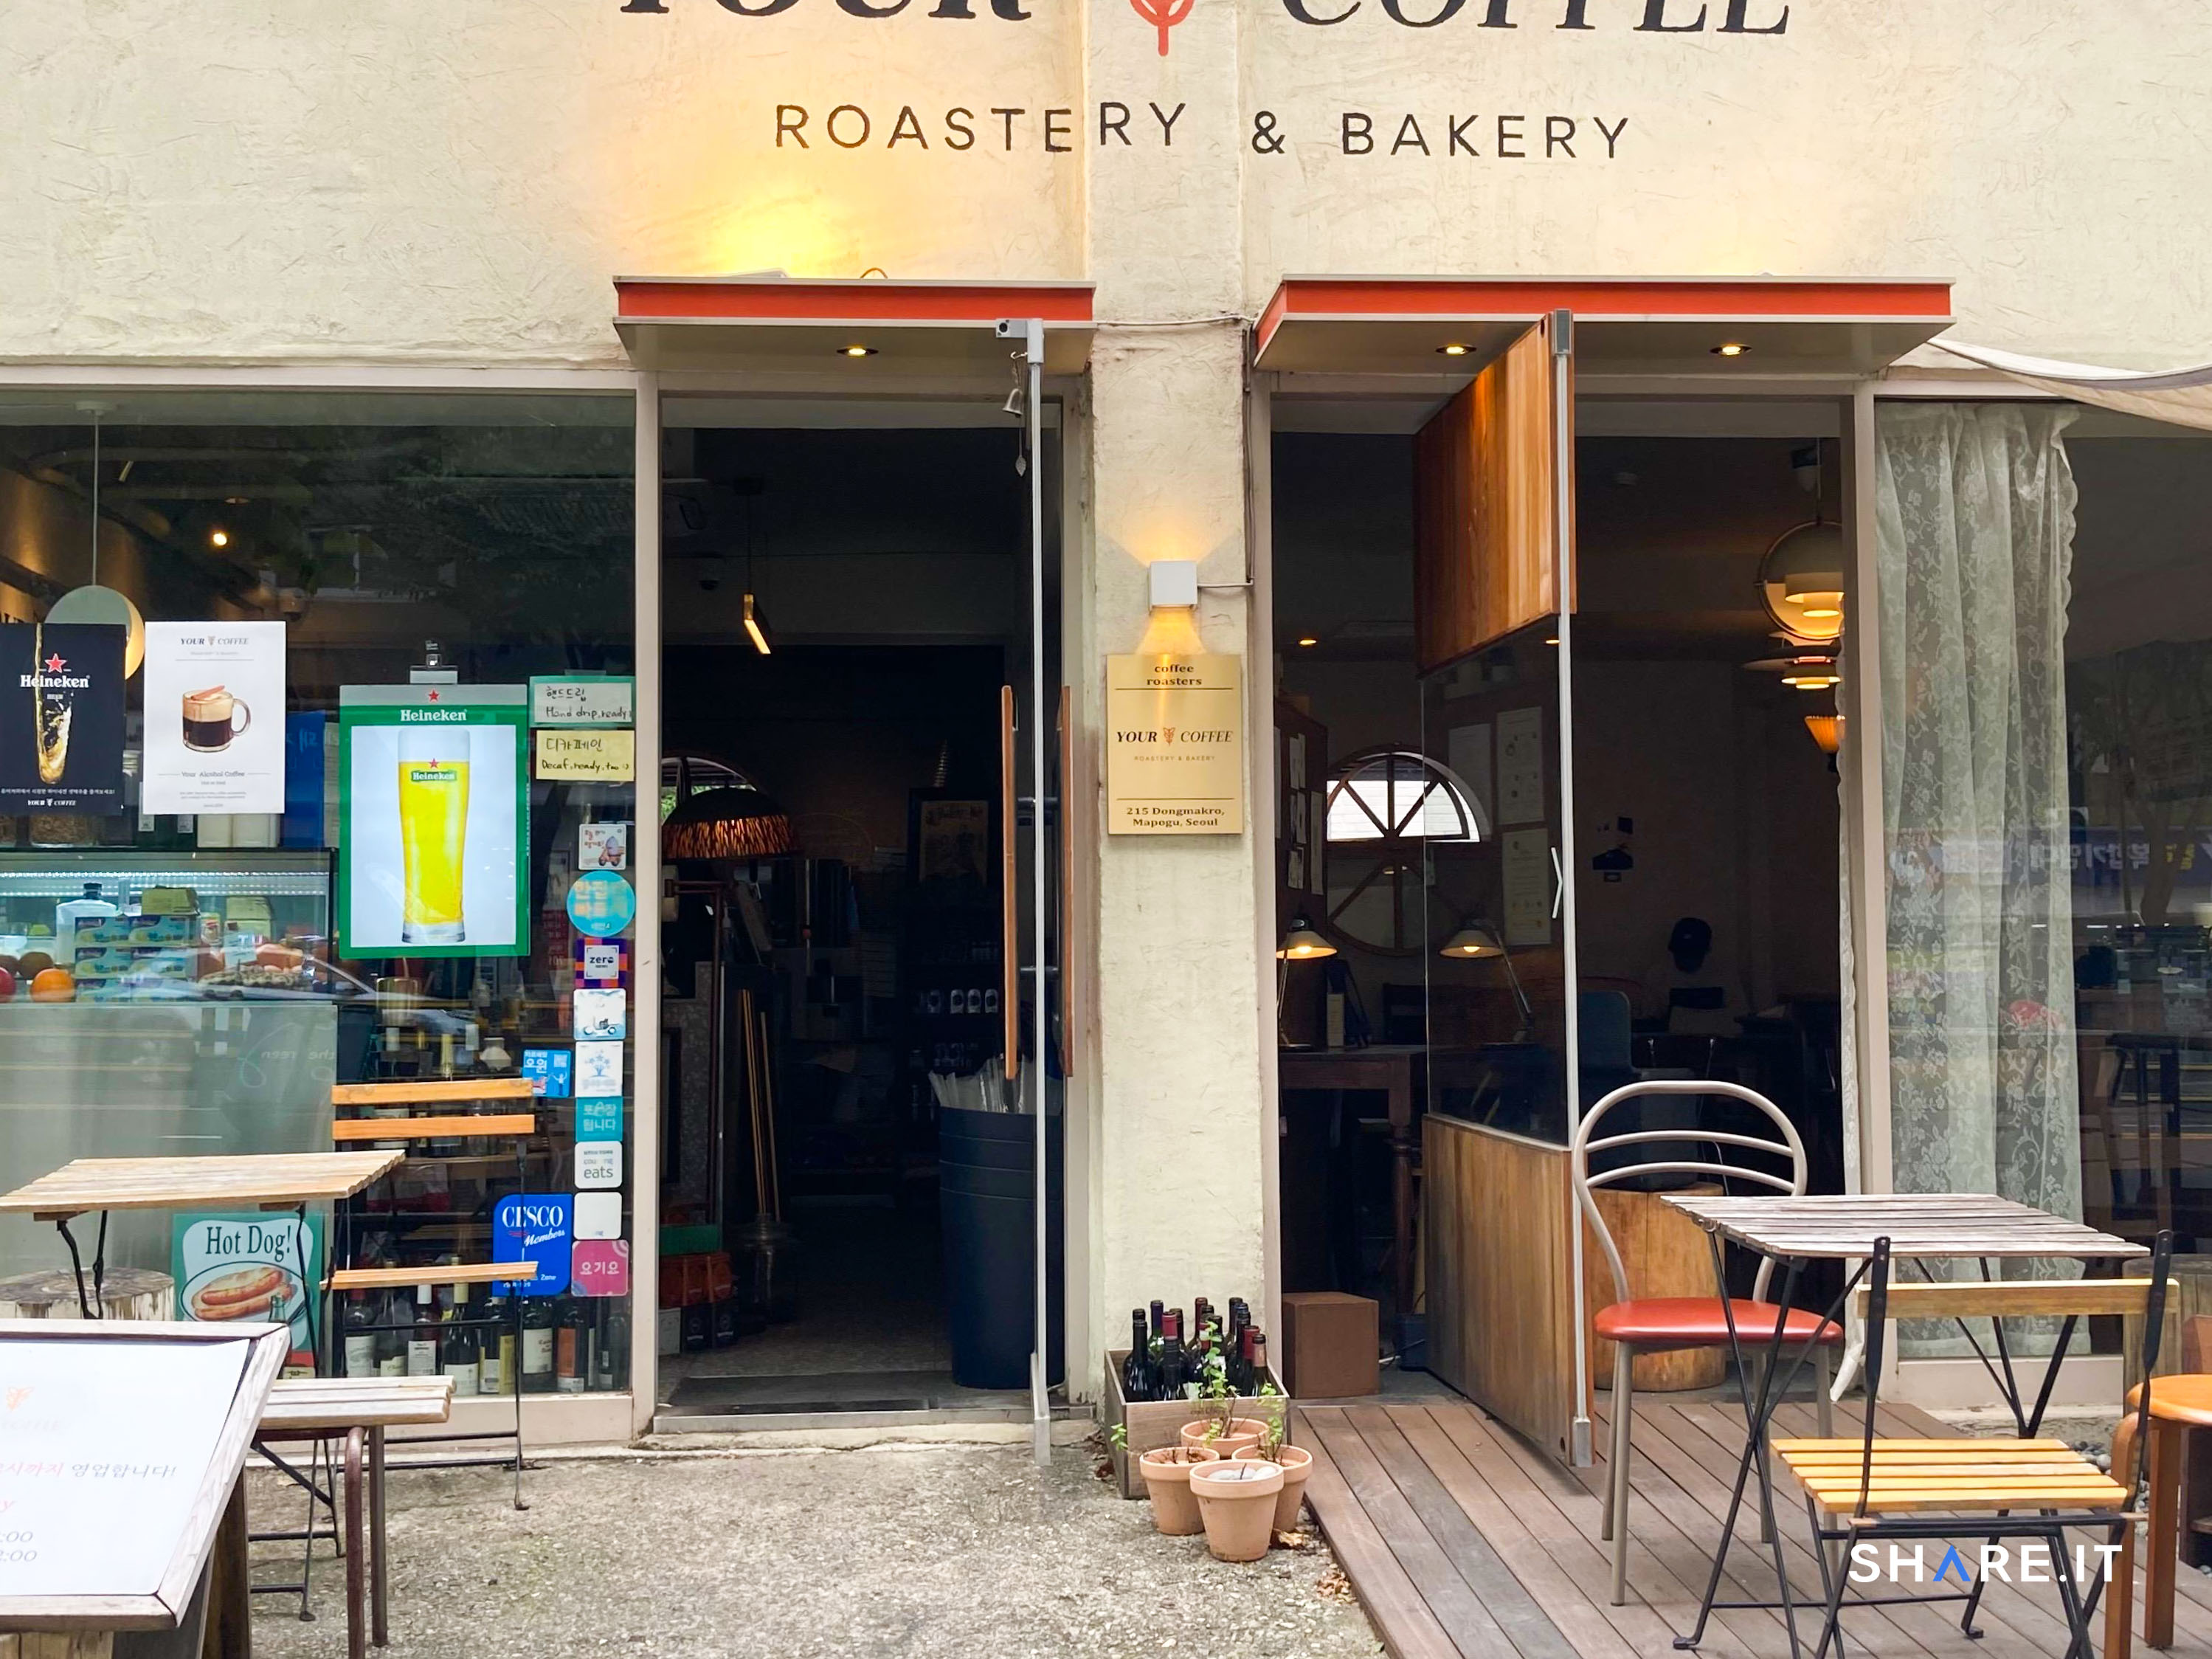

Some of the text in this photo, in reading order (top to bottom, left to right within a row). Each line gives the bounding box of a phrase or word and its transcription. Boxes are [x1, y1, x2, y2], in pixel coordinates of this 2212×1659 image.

[775, 101, 1628, 159] ROASTERY & BAKERY
[1155, 664, 1194, 673] coffee
[20, 675, 90, 688] Heineken
[401, 709, 467, 722] Heineken
[1116, 731, 1234, 742] YOUR COFFEE
[546, 738, 603, 752] 디카페인
[413, 772, 455, 781] Heineken
[1152, 807, 1225, 816] Dongmakro,
[1133, 818, 1218, 828] Mapogu, Seoul
[584, 1165, 614, 1179] eats
[502, 1205, 564, 1227] CESCO
[205, 1225, 291, 1263] Hot Dog!
[524, 1228, 566, 1247] Members
[580, 1261, 620, 1275] 요기요
[72, 1463, 177, 1478] 영업합니다!
